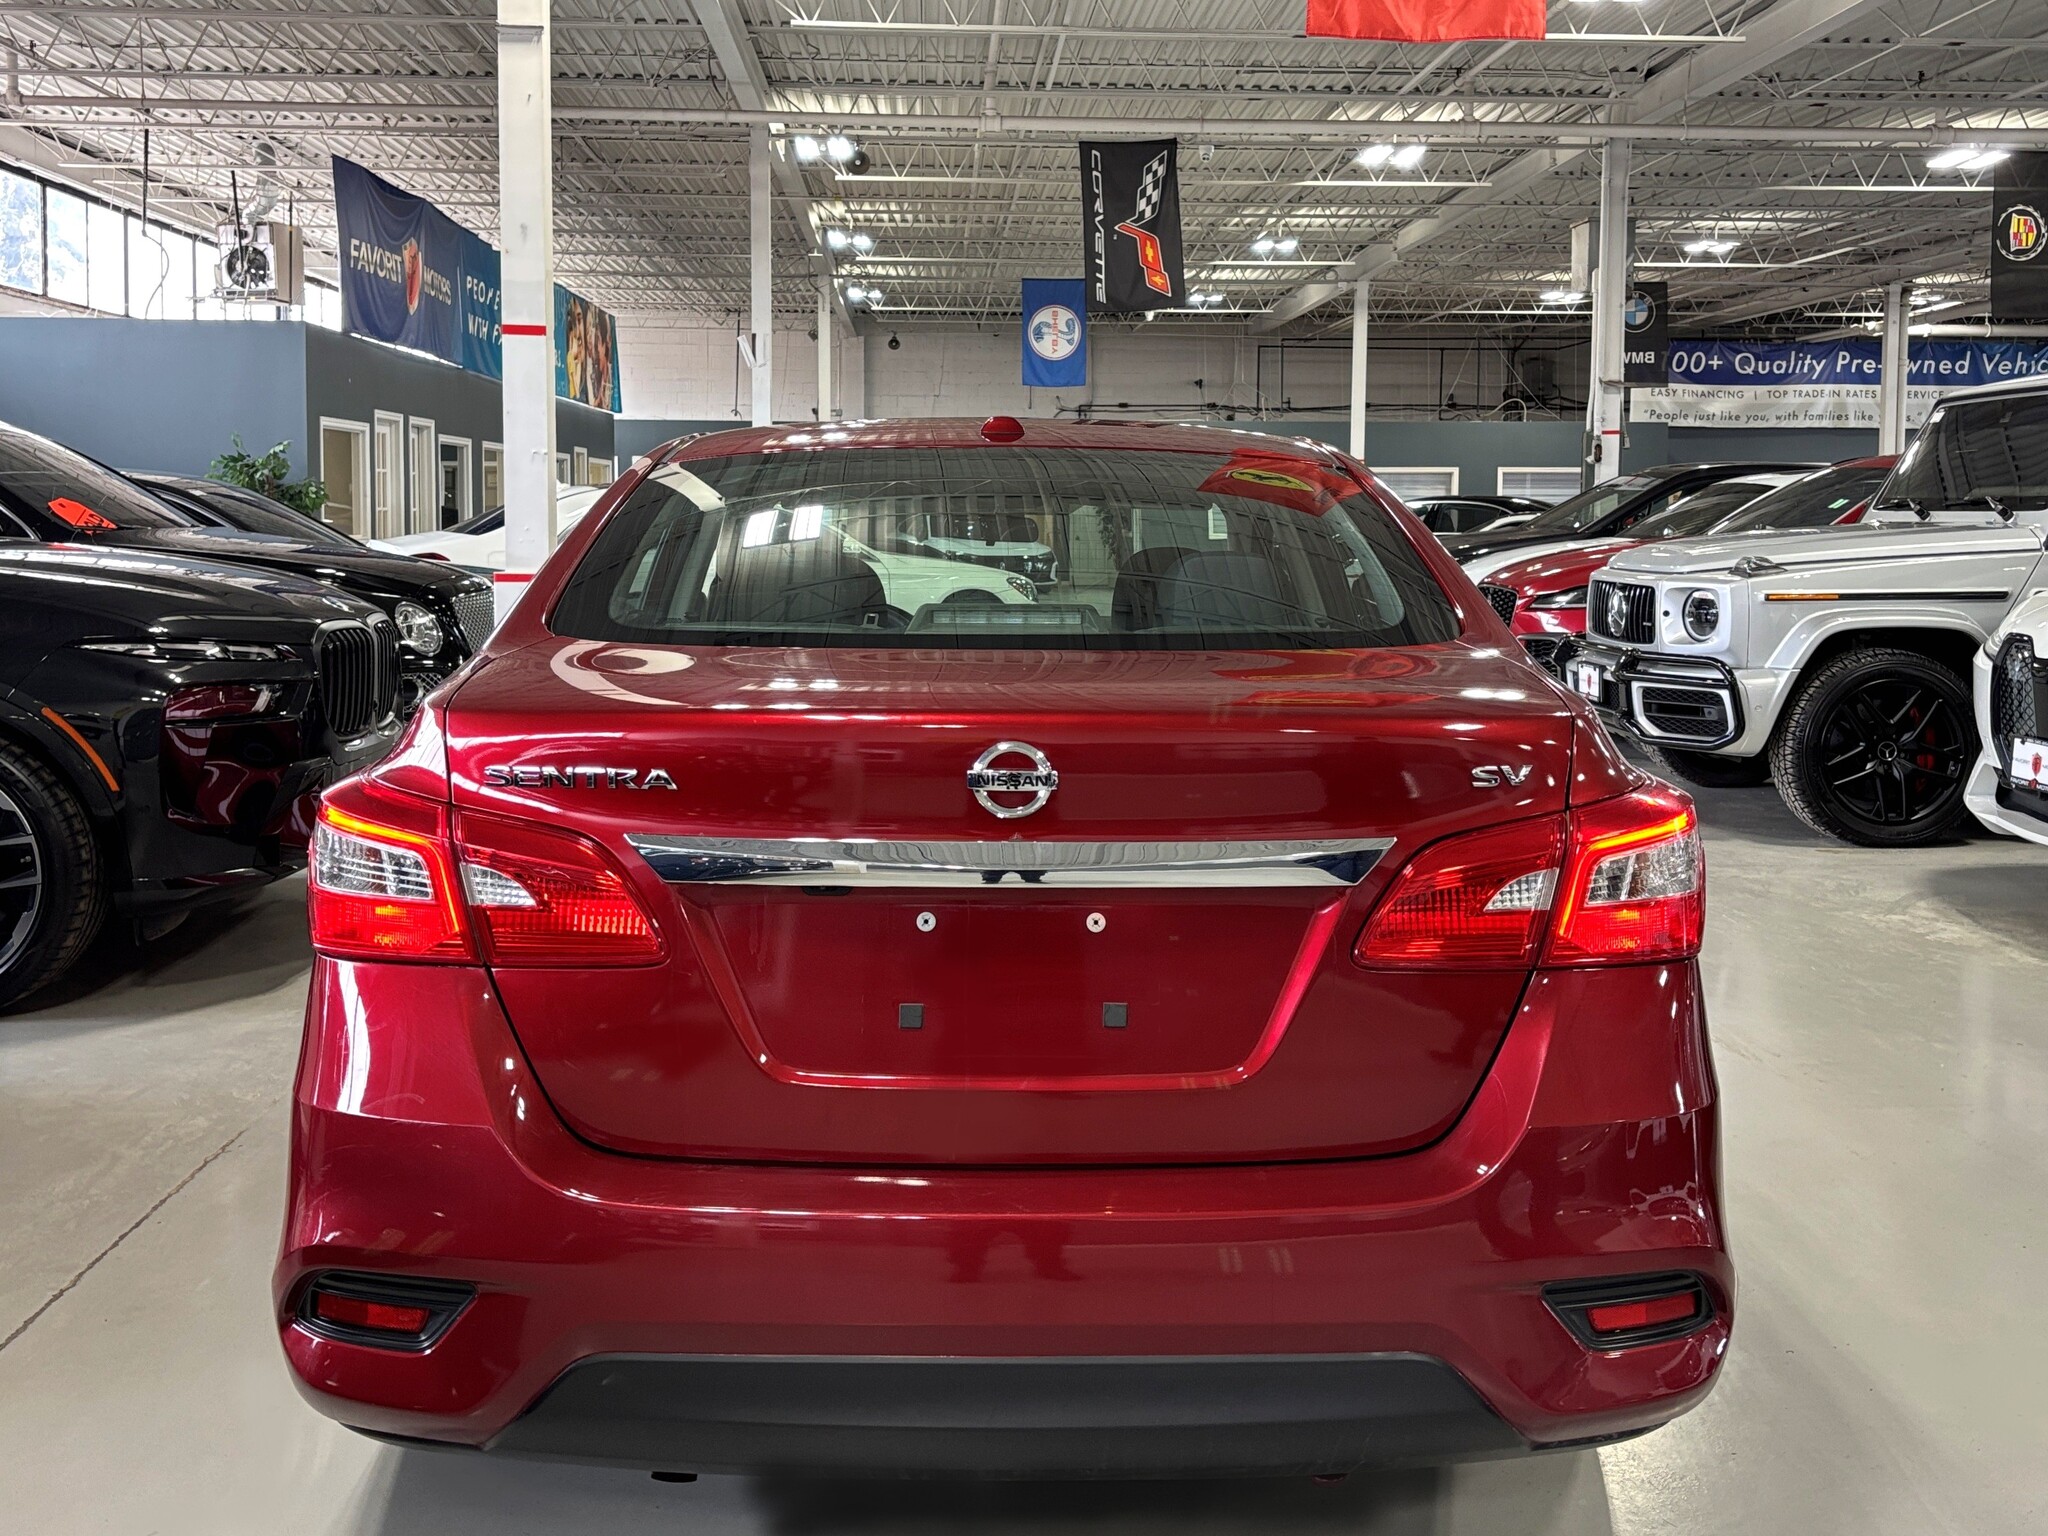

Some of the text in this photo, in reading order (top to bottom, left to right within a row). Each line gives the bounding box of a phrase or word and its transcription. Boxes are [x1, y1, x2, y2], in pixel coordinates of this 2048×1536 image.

[1091, 150, 1107, 304] CORVETTE
[350, 238, 452, 306] FAVORIT MOTORS
[467, 312, 489, 342] WITH
[1734, 350, 1827, 380] Quality
[1650, 388, 1945, 400] EASY FINANCING TOP TRADE-IN RATES ERVICE
[1694, 410, 1717, 423] just
[1720, 410, 1742, 422] like
[1745, 414, 1770, 424] you,
[1775, 410, 1799, 422] with
[1803, 409, 1850, 422] families
[1853, 410, 1874, 422] like
[484, 764, 678, 791] SENTRA
[976, 774, 1048, 787] NISSAN
[1471, 764, 1533, 788] SV
